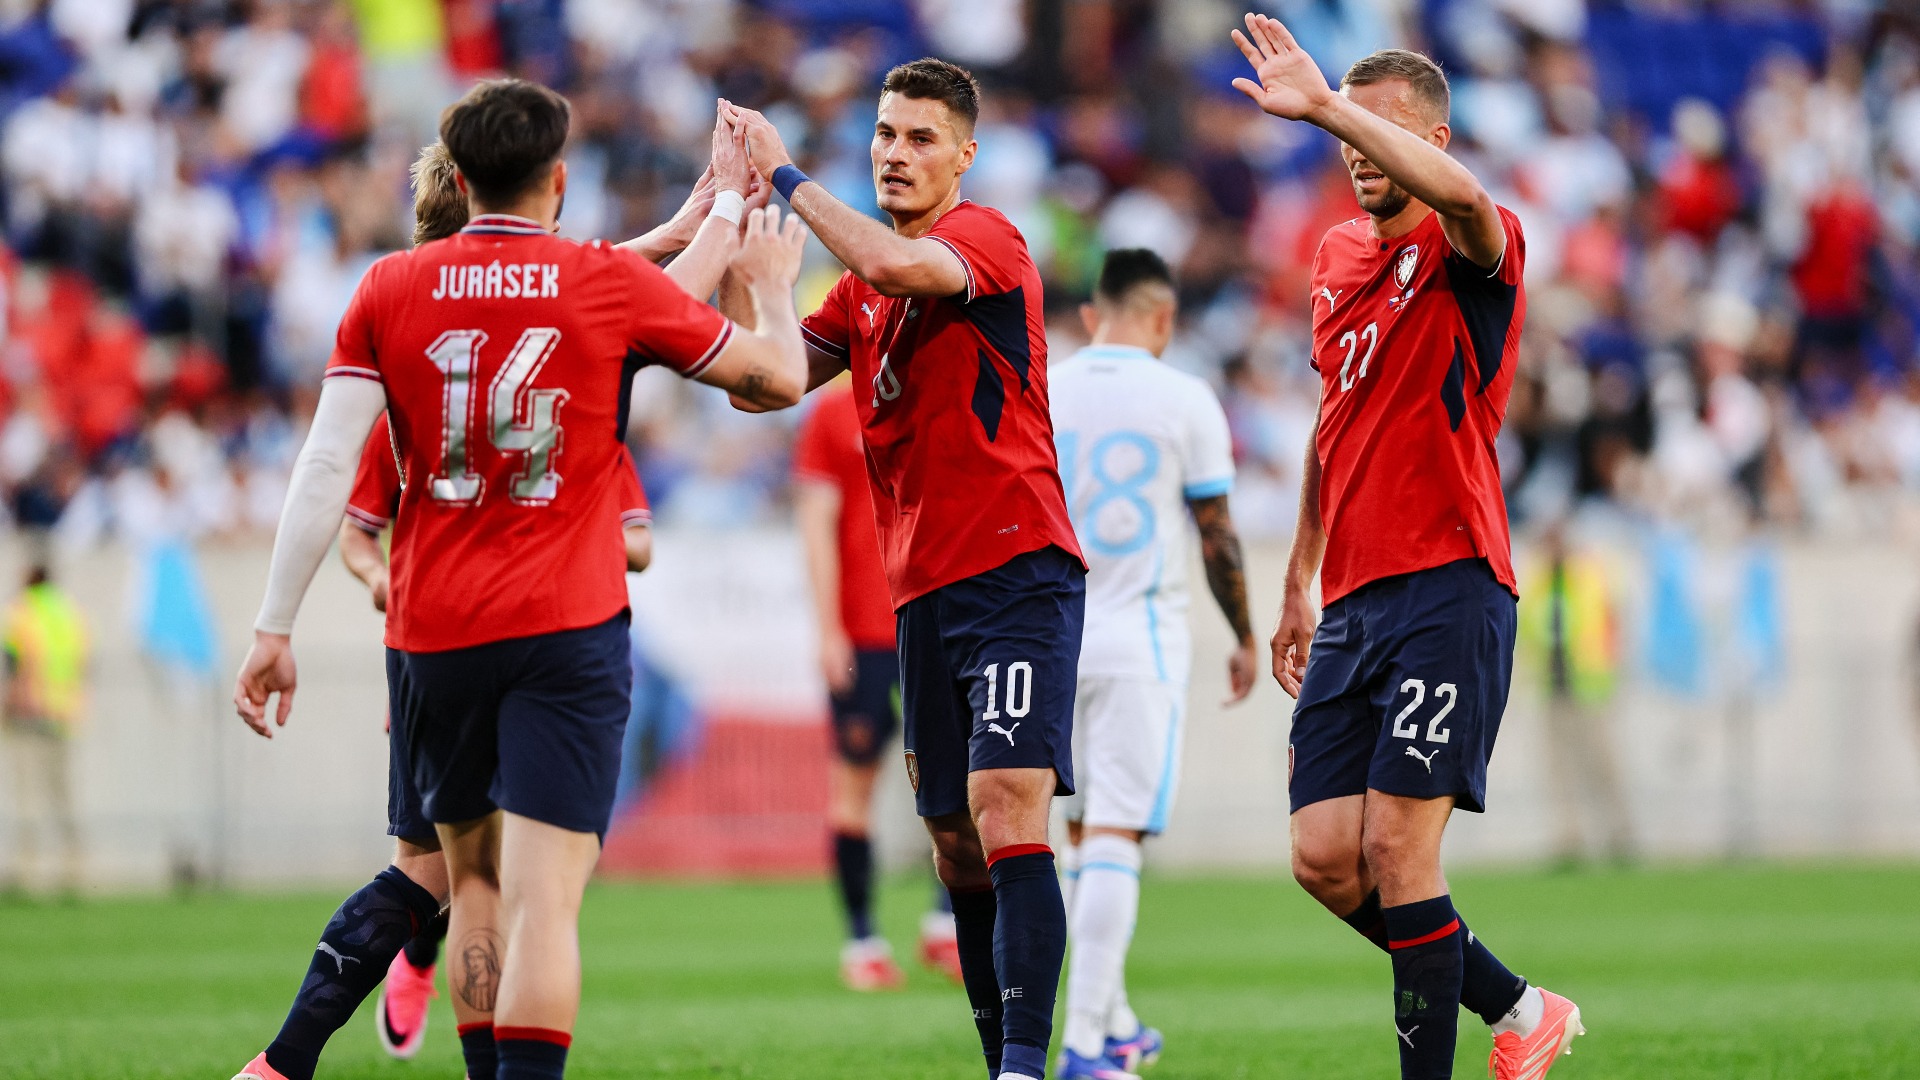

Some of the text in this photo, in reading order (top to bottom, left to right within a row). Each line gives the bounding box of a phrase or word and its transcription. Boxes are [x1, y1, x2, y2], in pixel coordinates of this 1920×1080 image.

[432, 259, 559, 300] JURÁSEK
[424, 327, 571, 507] 14
[1054, 430, 1162, 557] 18
[982, 661, 1033, 721] 10
[1392, 678, 1458, 744] 22
